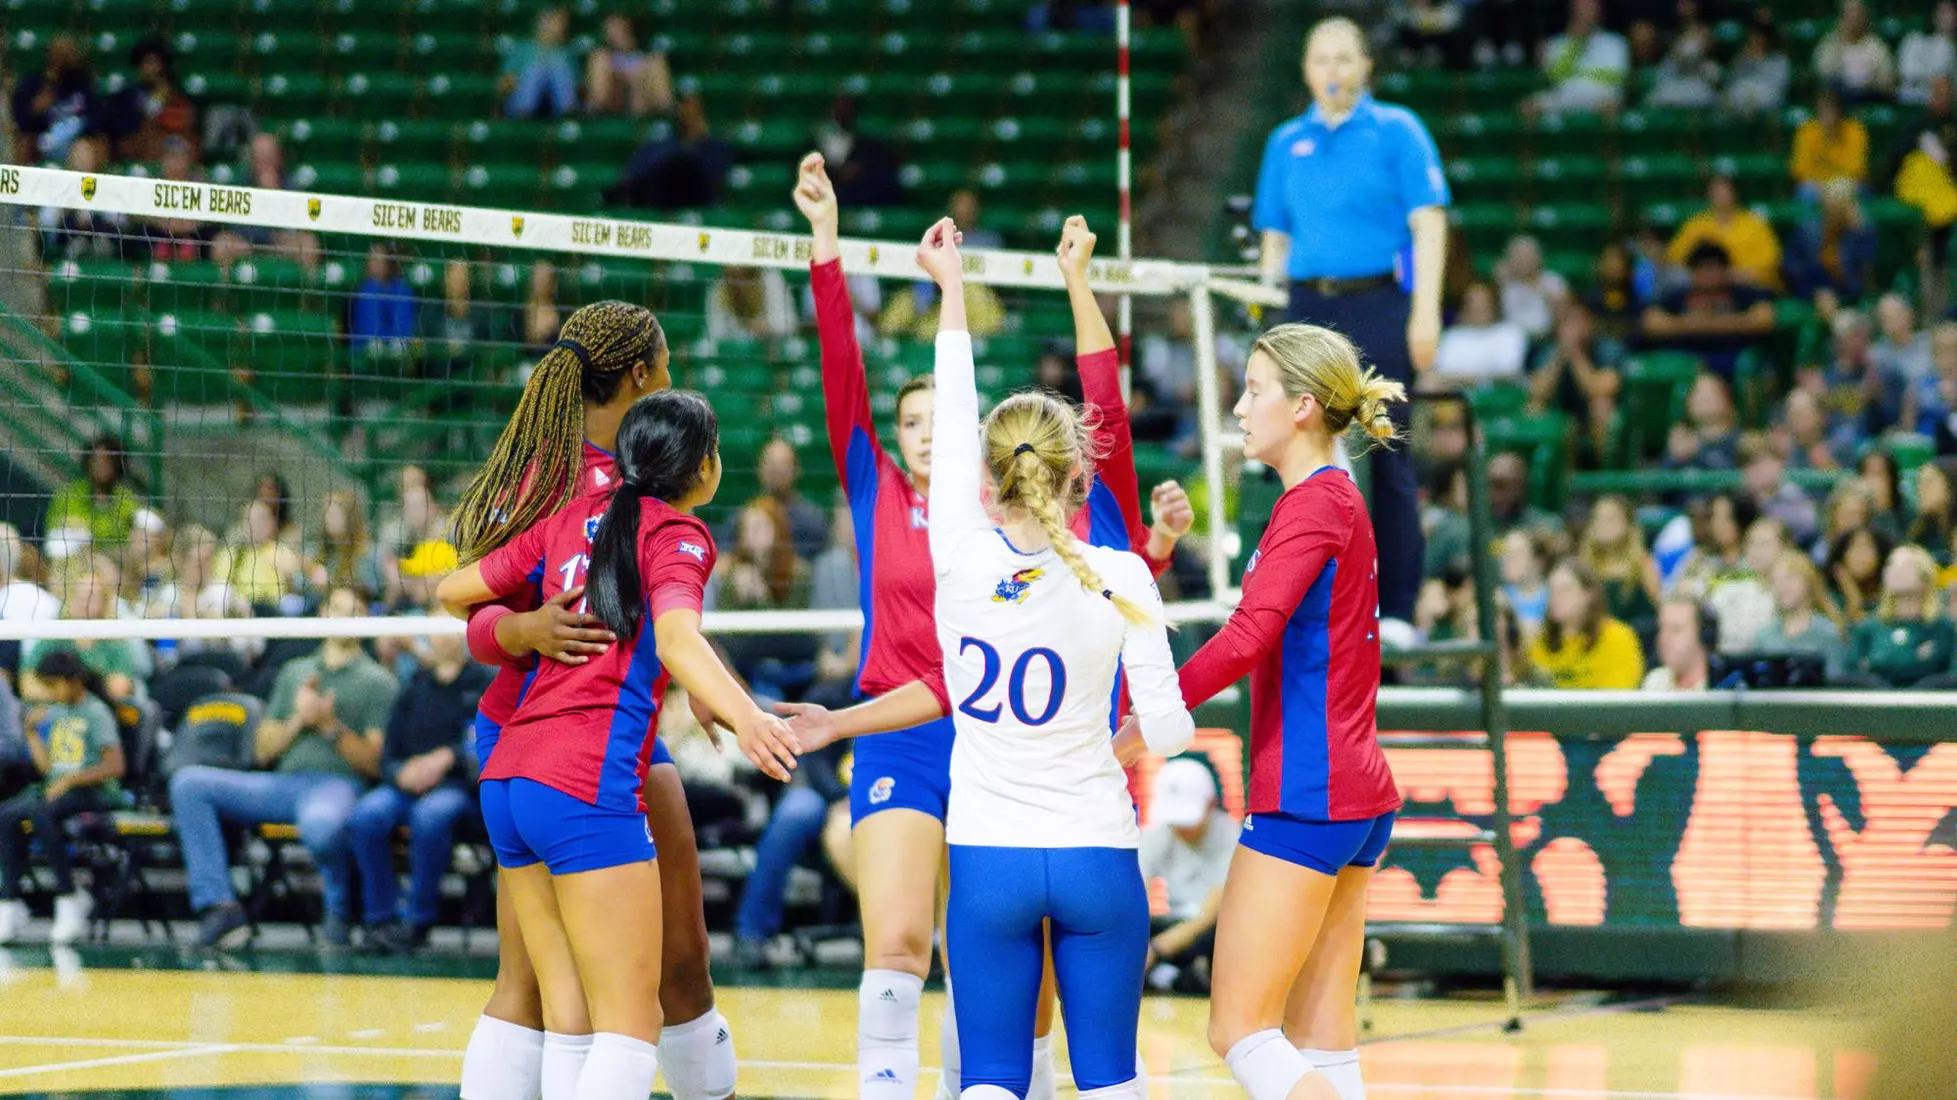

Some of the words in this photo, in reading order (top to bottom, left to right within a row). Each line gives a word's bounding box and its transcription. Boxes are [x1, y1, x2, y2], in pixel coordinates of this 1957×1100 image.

[153, 183, 202, 211] SIC'EM
[209, 188, 253, 215] BEARS
[372, 204, 416, 228] SIC'EM
[423, 208, 462, 233] BEARS
[616, 225, 653, 249] BEARS
[958, 636, 1067, 727] 20
